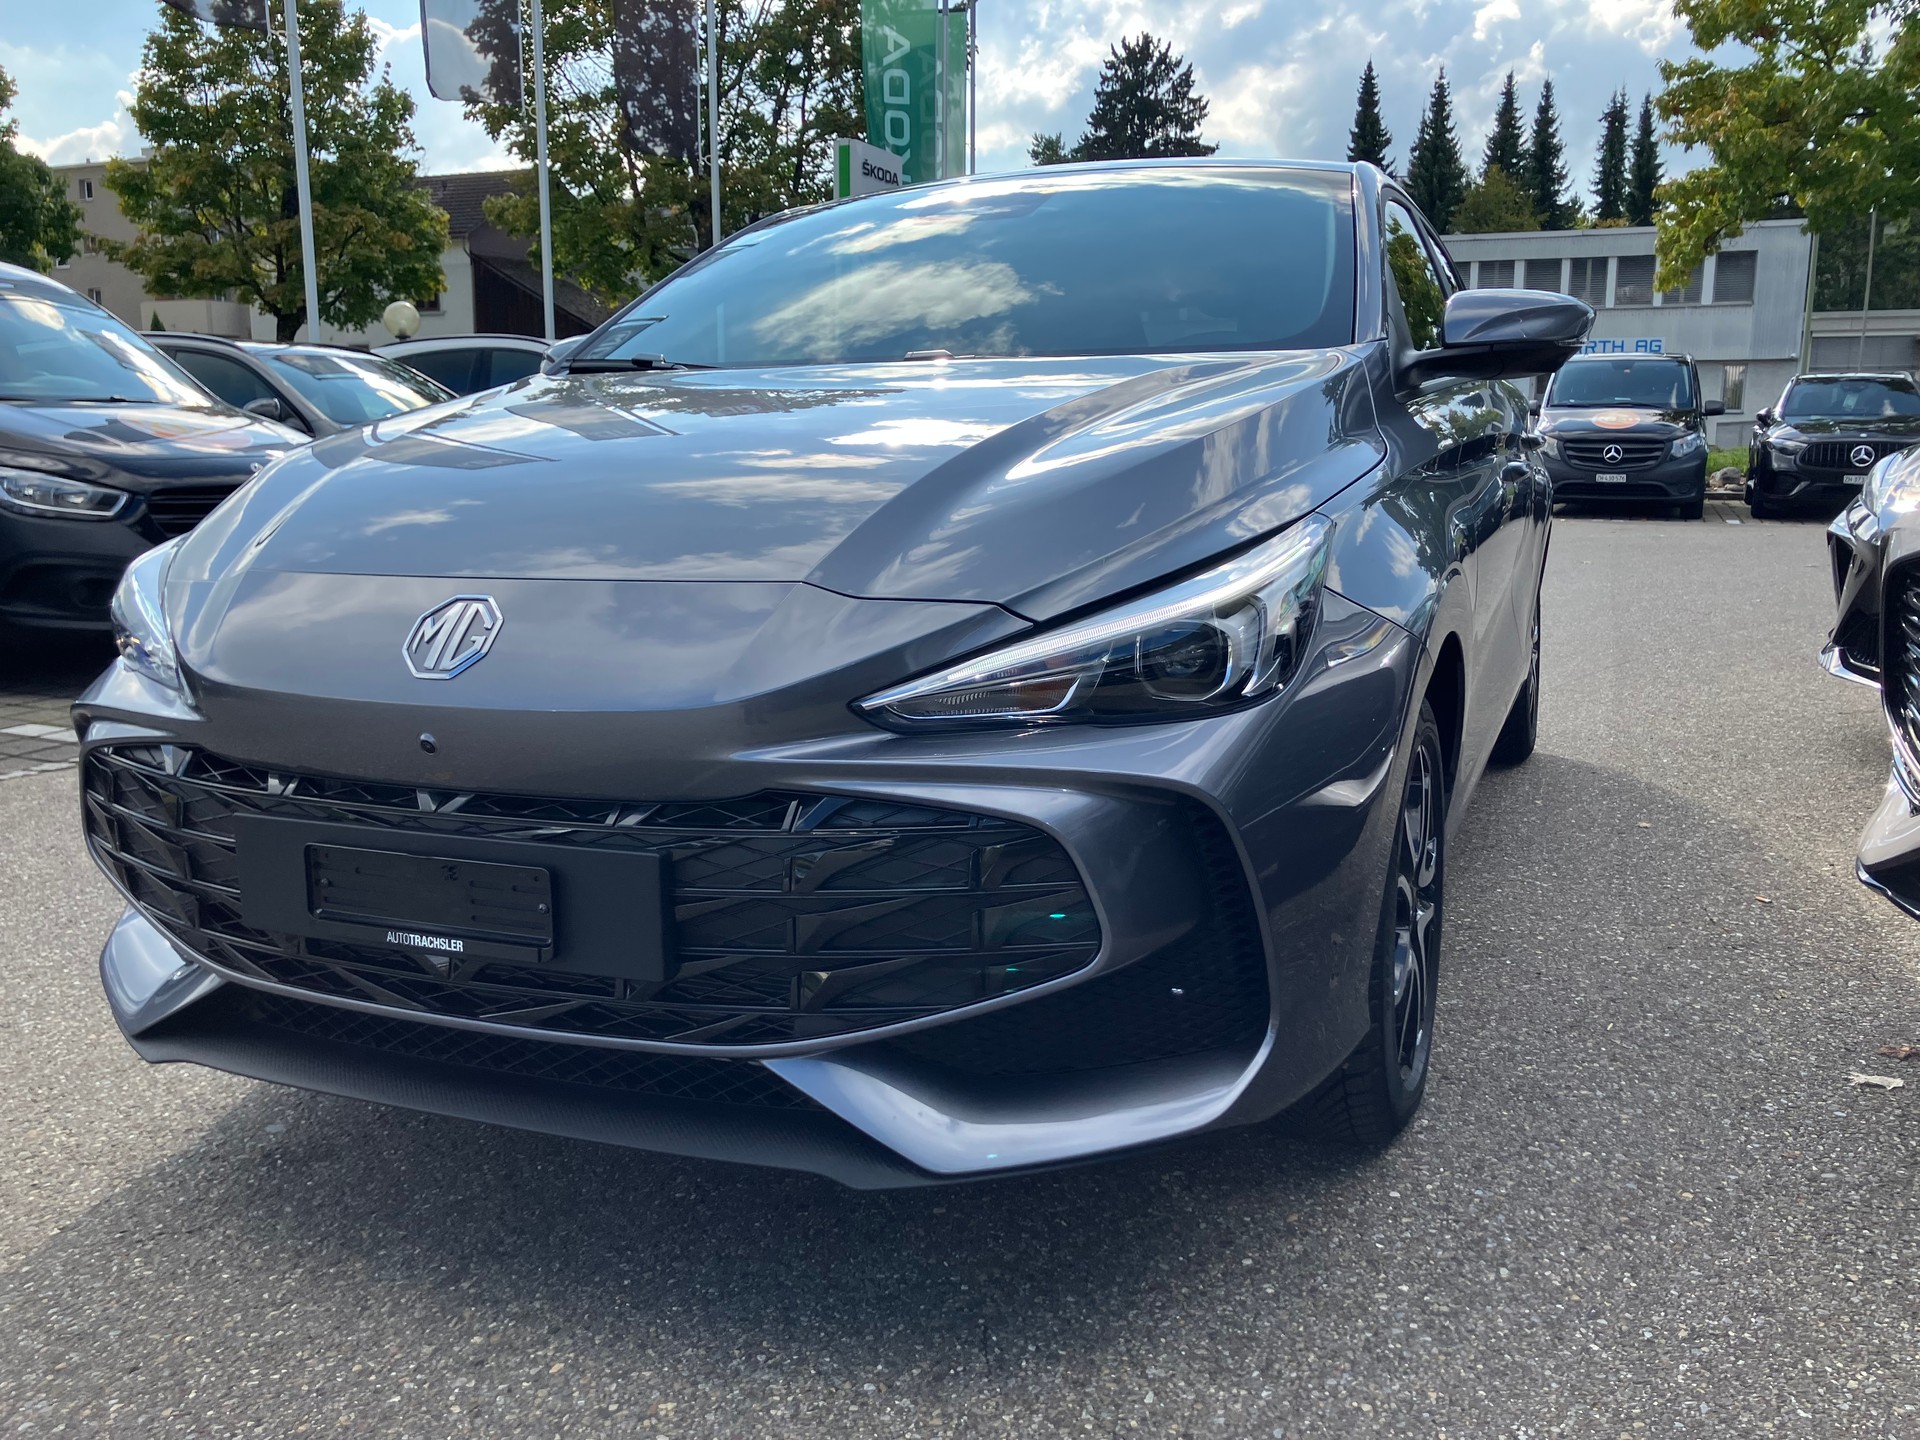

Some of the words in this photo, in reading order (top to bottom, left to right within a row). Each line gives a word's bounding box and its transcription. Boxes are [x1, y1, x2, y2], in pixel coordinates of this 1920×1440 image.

[862, 159, 899, 186] ŠKODA
[1579, 340, 1624, 353] RTH
[1636, 339, 1662, 353] AG
[412, 602, 494, 670] MG
